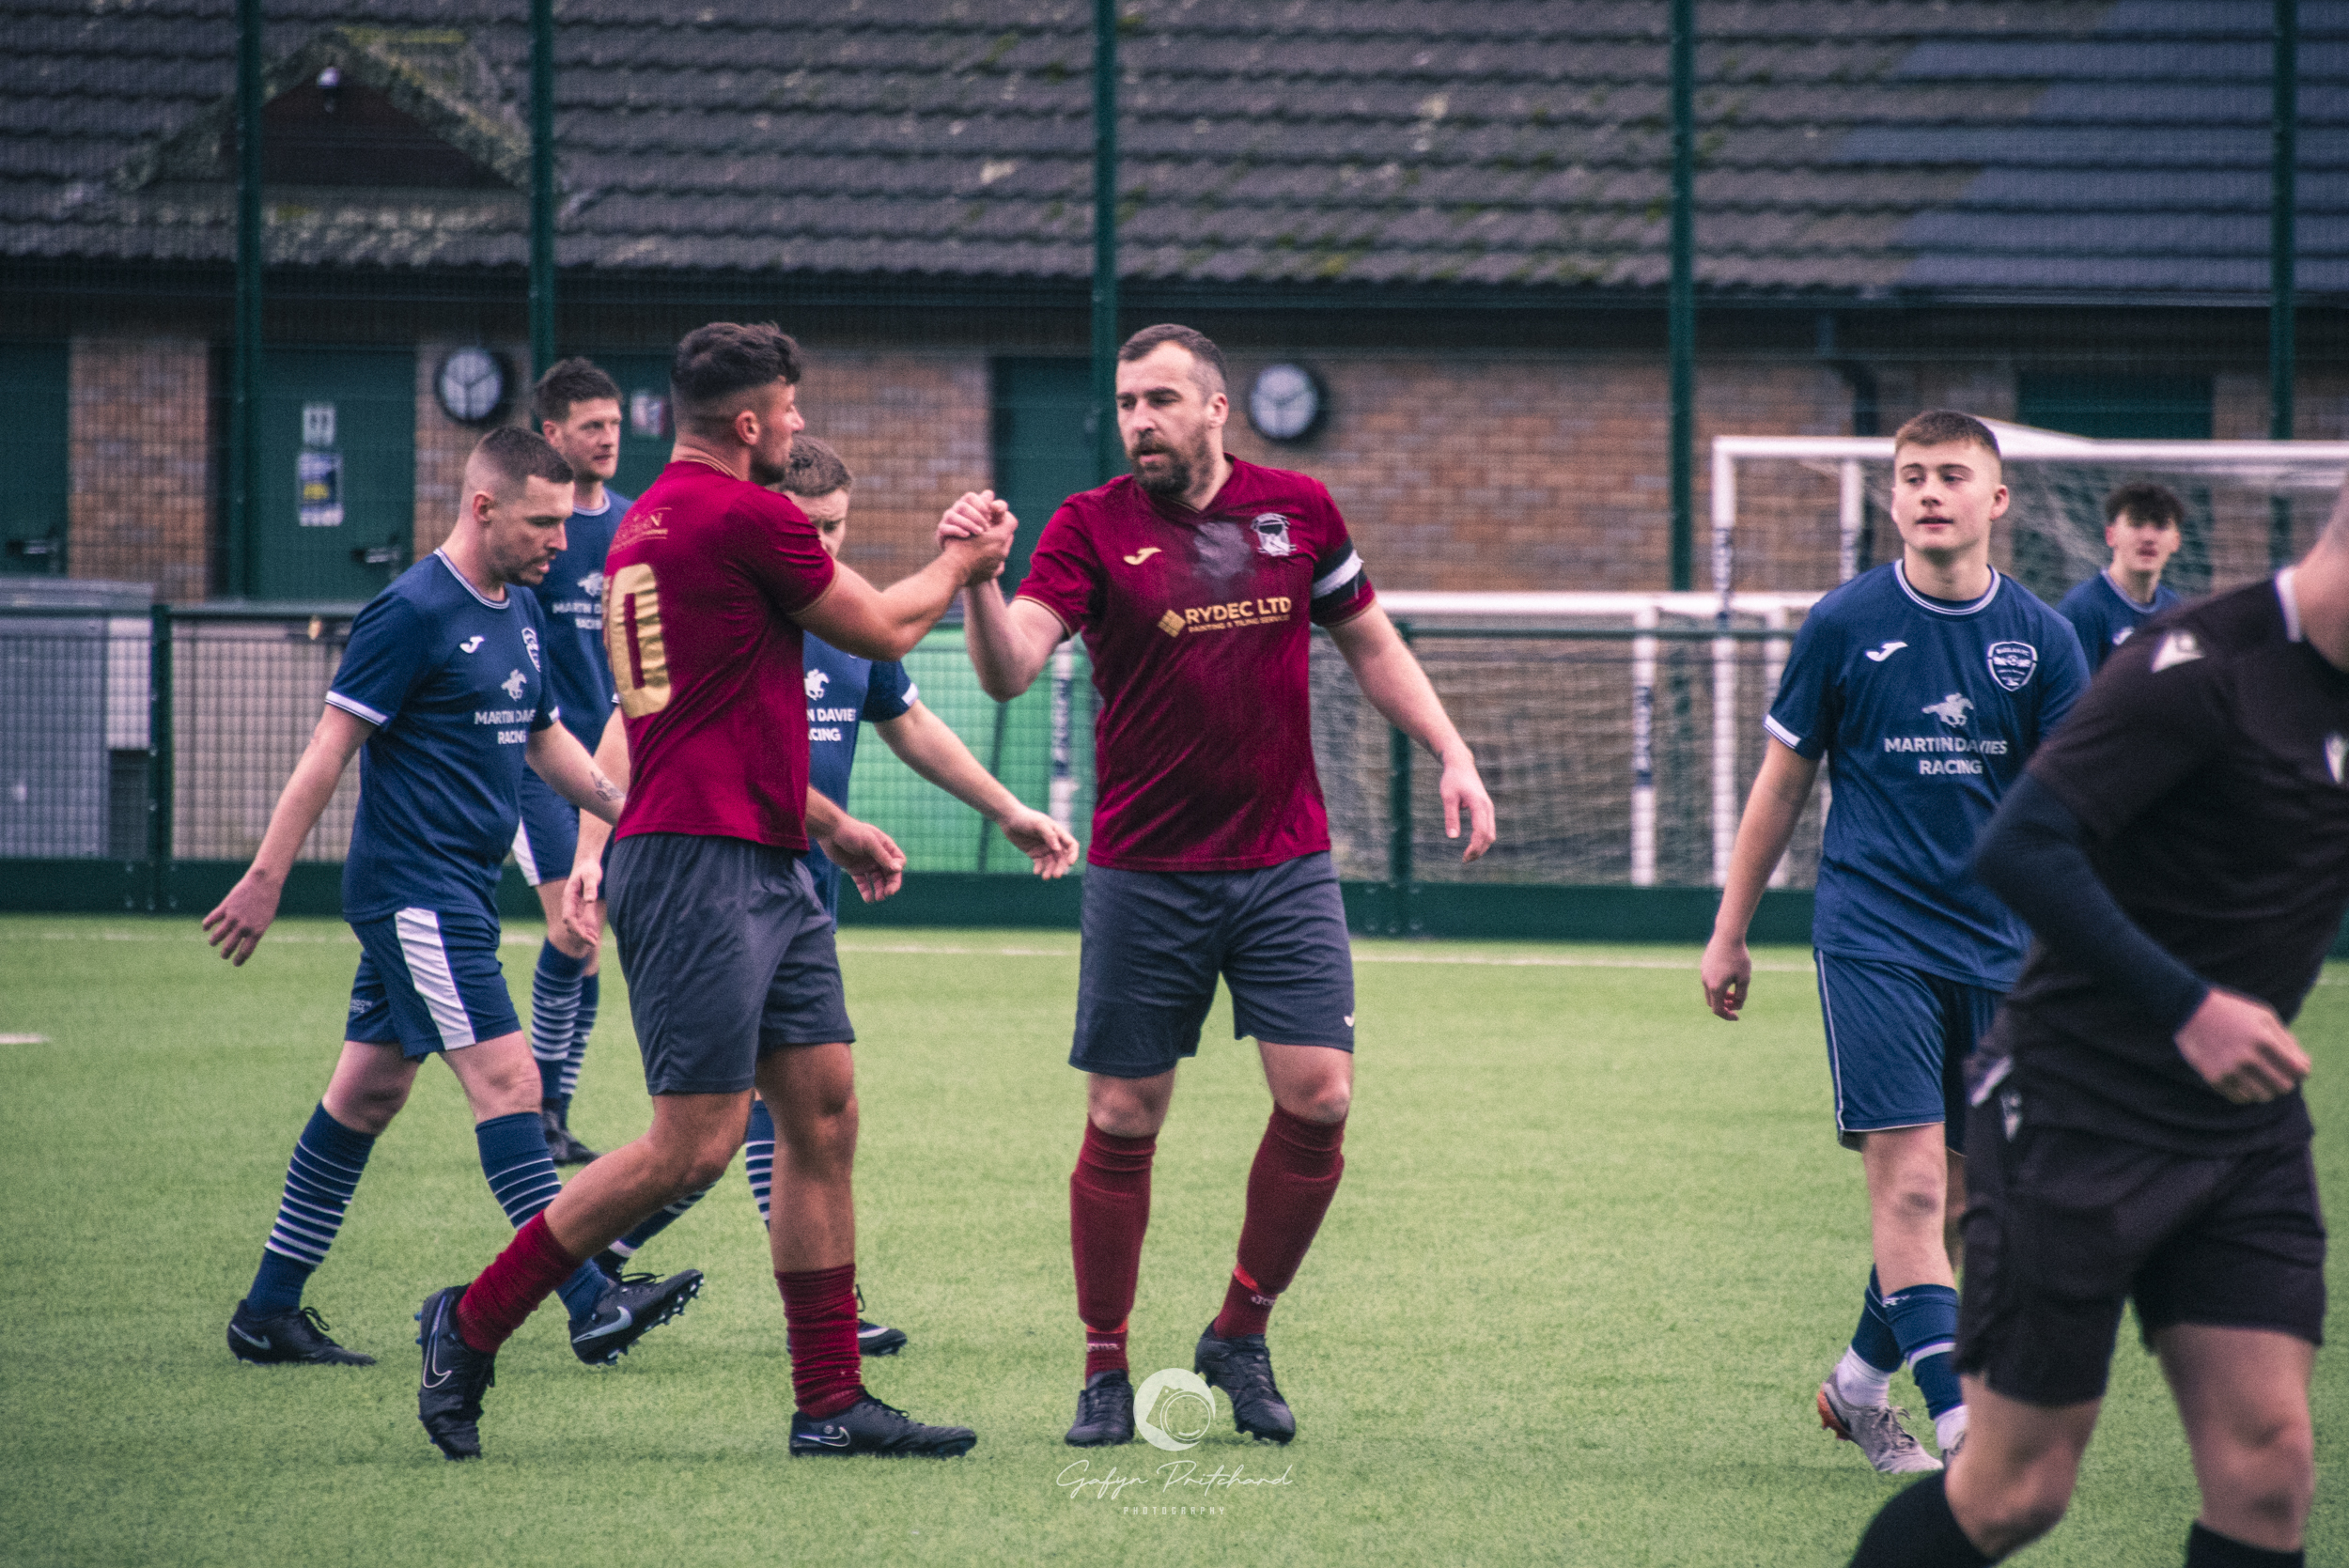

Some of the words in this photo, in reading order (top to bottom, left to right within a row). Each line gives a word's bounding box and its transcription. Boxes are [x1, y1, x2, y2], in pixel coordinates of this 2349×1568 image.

[1184, 600, 1254, 624] RYDEC
[1256, 597, 1292, 615] LTD
[474, 710, 514, 724] MARTIN
[817, 708, 856, 722] DAVIE
[1884, 737, 1954, 753] MARTIN
[1919, 759, 1983, 775] RACING
